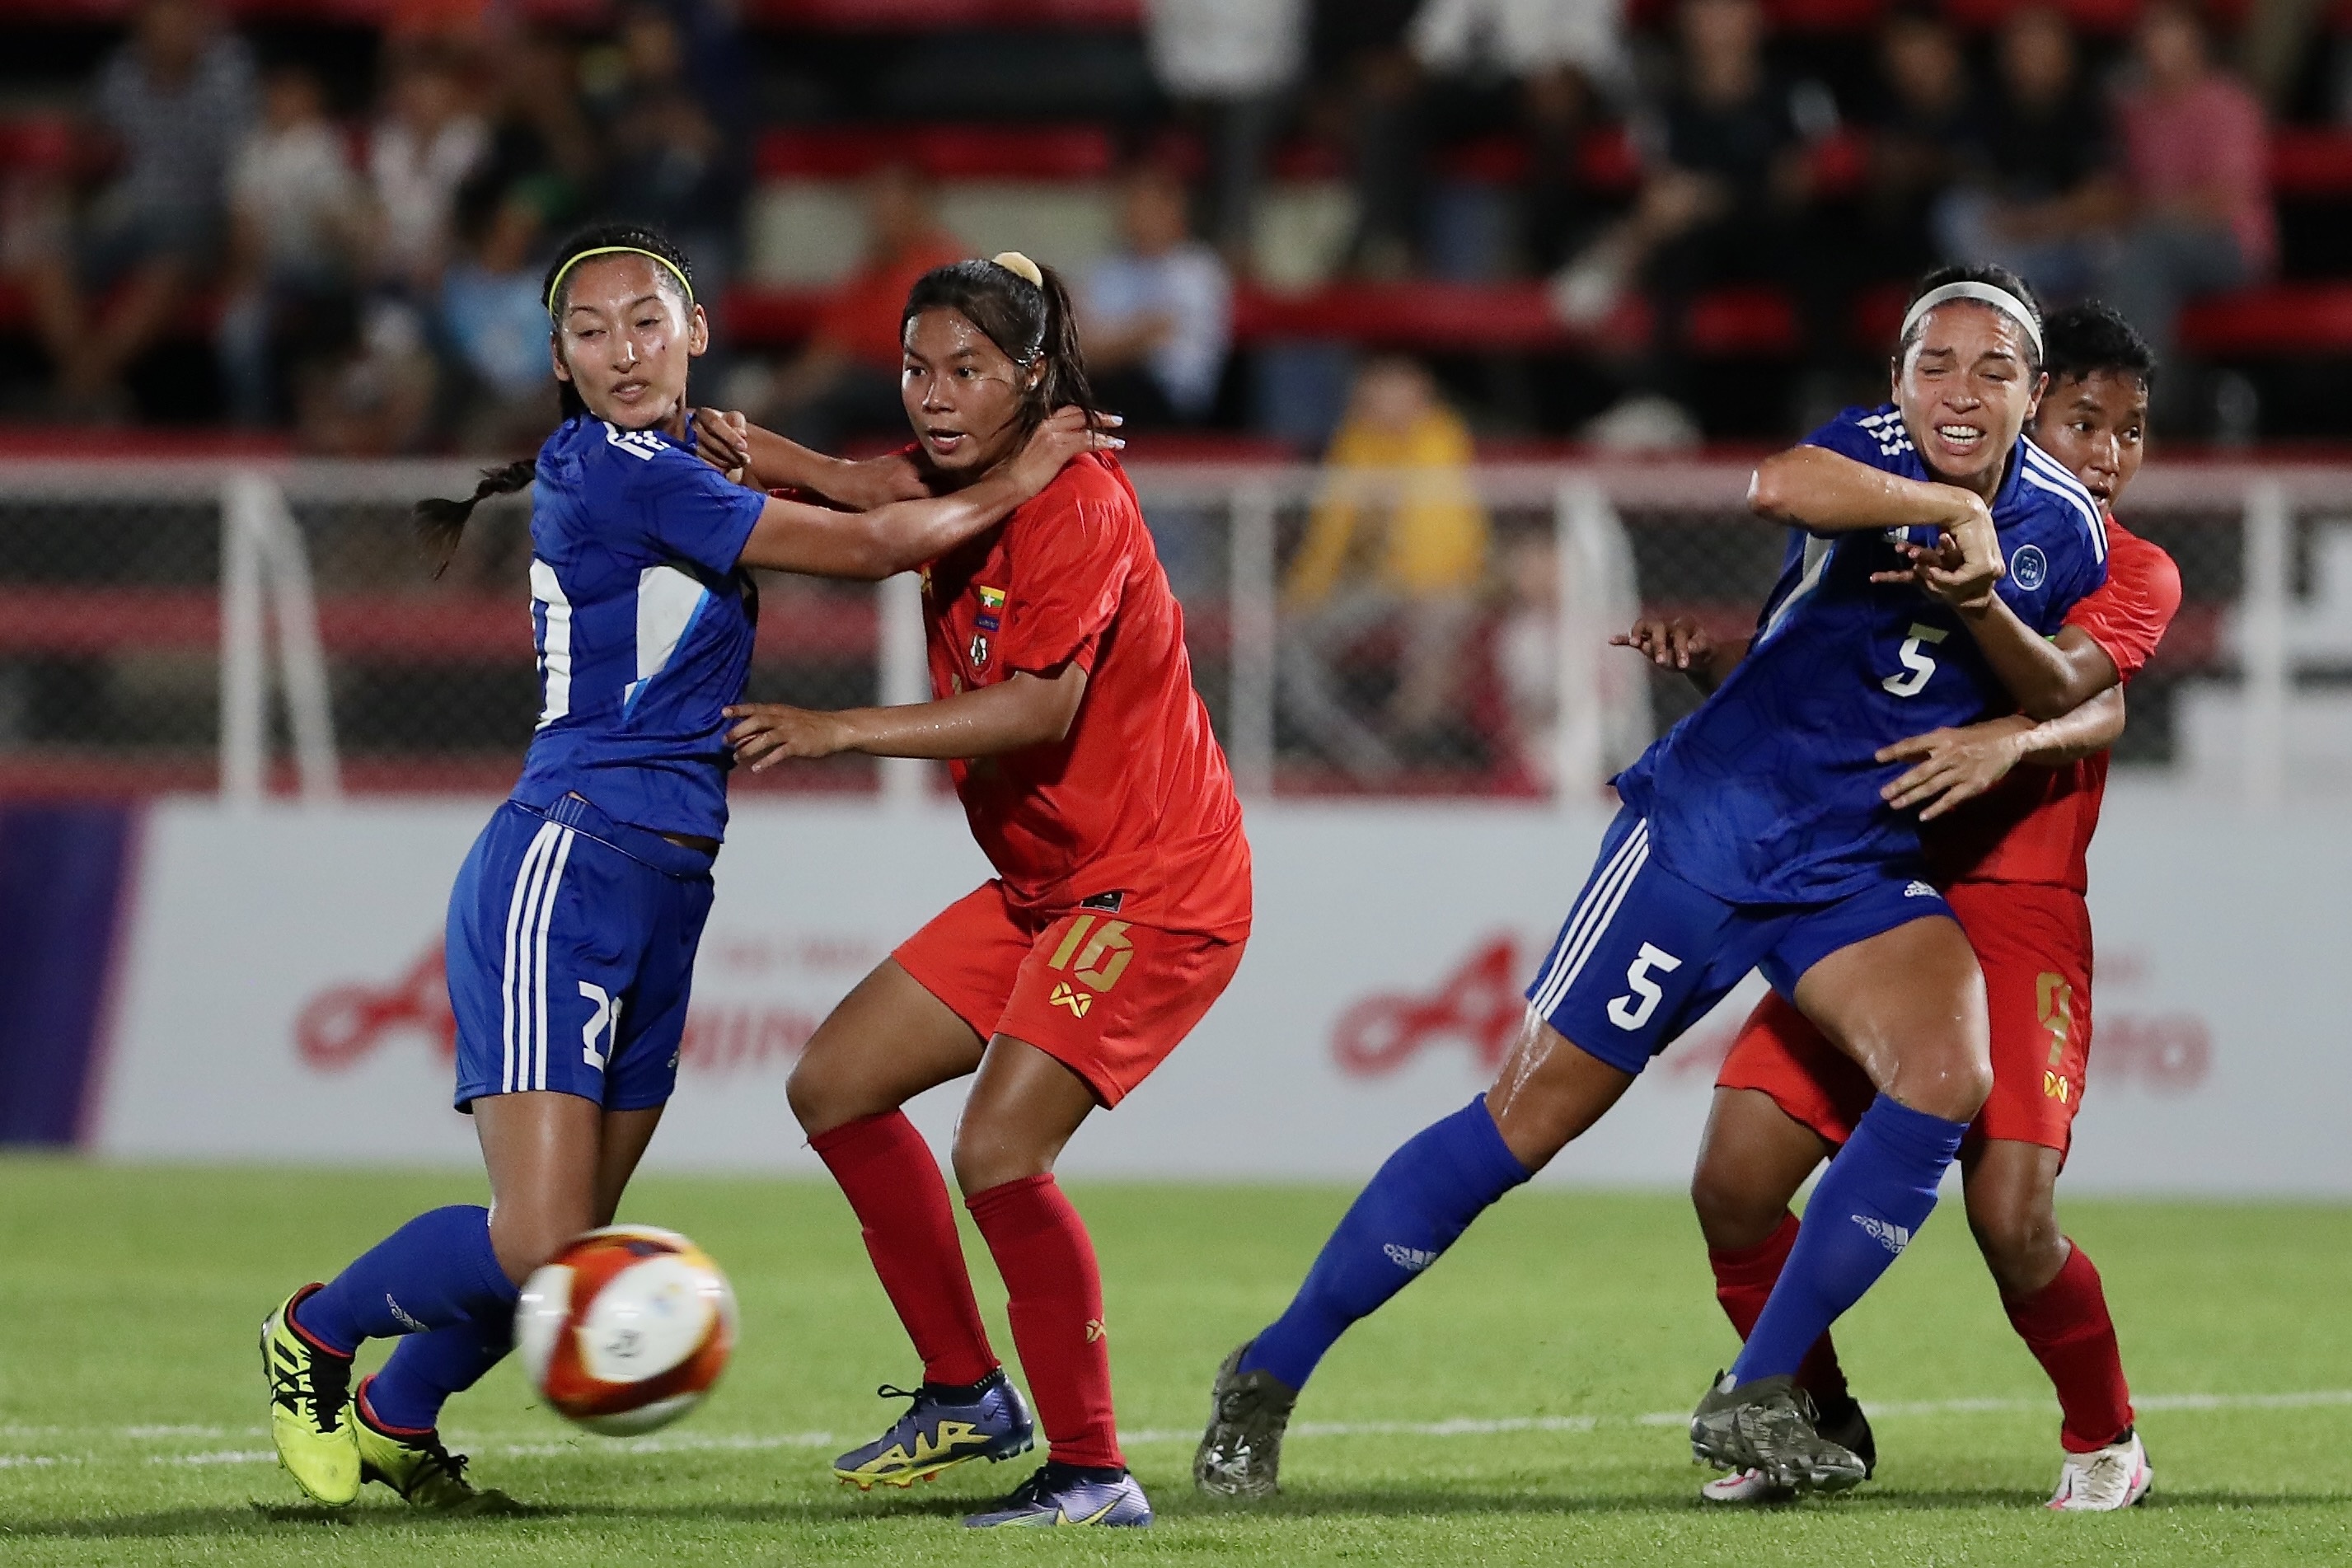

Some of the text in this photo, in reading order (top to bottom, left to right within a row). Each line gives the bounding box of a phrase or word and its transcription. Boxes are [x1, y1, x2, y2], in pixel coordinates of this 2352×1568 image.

[1881, 622, 1949, 697] 5
[1047, 914, 1134, 992] 16
[1607, 941, 1683, 1031] 5
[2036, 971, 2072, 1066] 9
